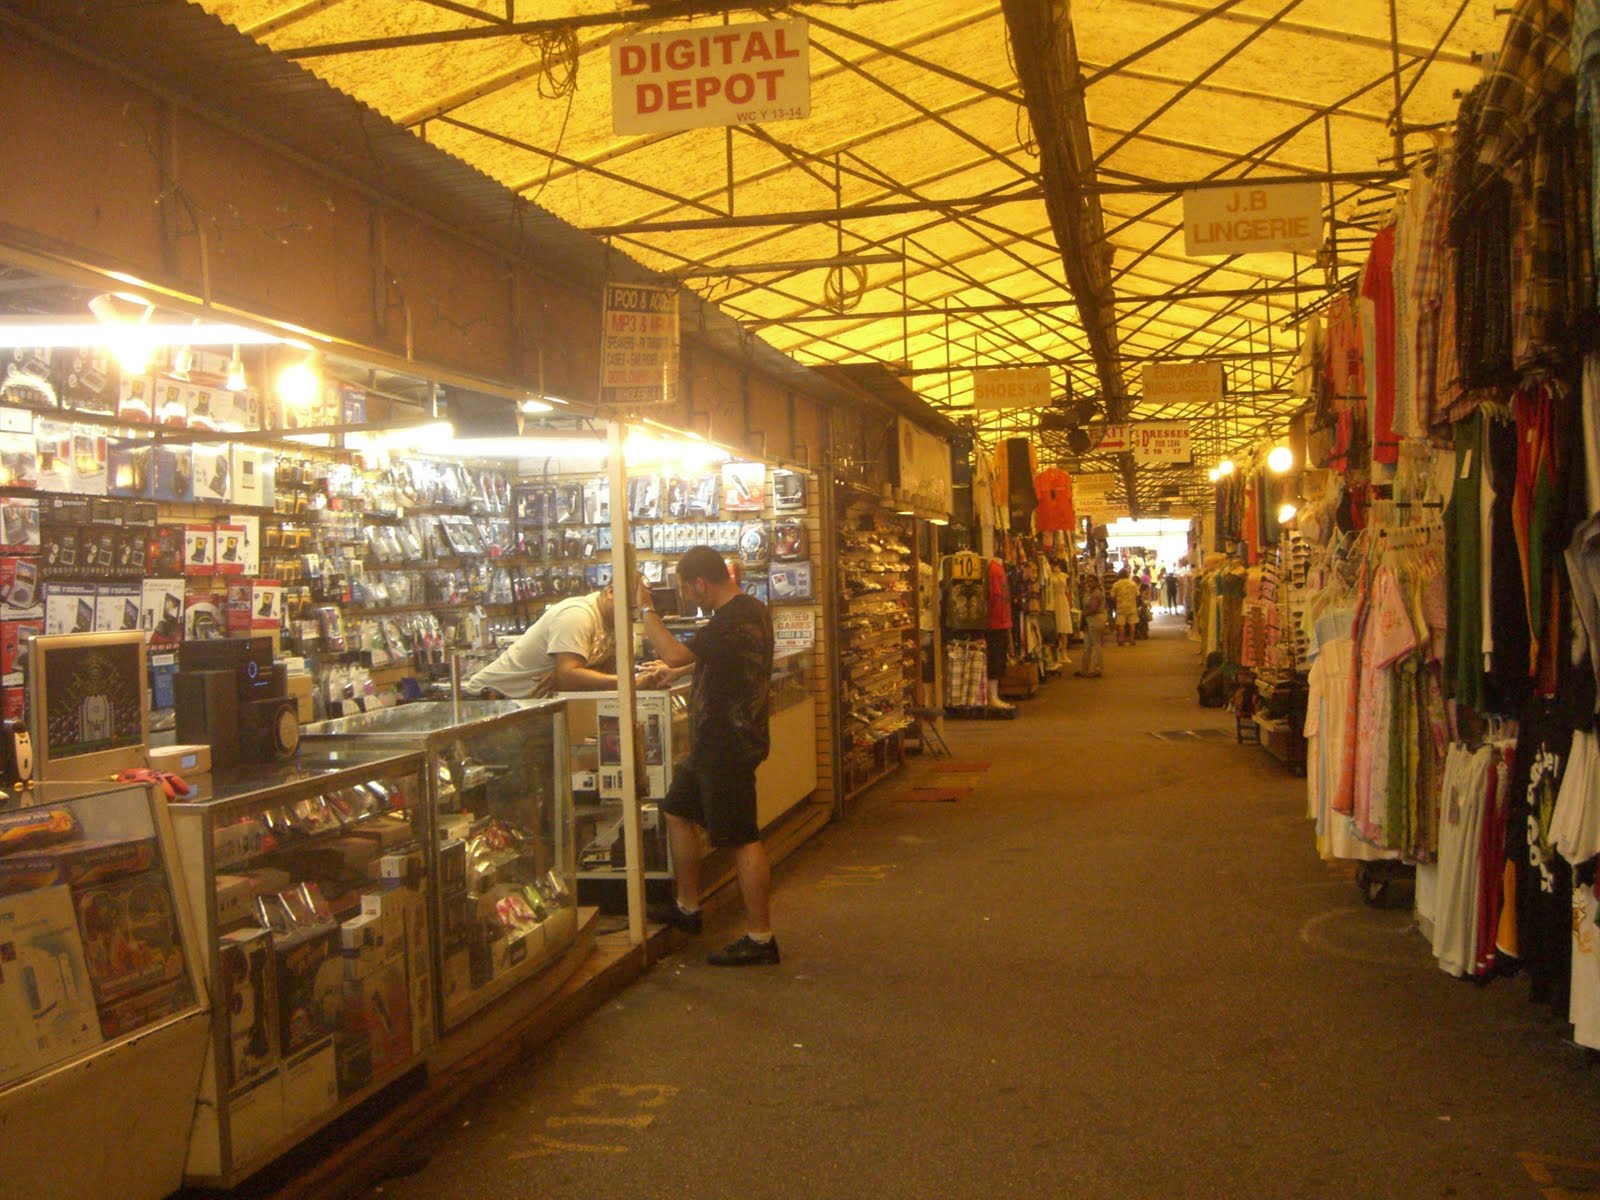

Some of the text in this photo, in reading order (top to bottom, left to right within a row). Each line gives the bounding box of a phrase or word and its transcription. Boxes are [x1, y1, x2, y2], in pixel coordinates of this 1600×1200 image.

[619, 28, 800, 76] DIGITAL
[636, 69, 785, 115] DEPOT
[736, 106, 802, 122] WC Y 13-14
[1226, 190, 1268, 212] J.B
[1192, 217, 1312, 244] LINGERIE
[1141, 429, 1190, 448] DRESSES
